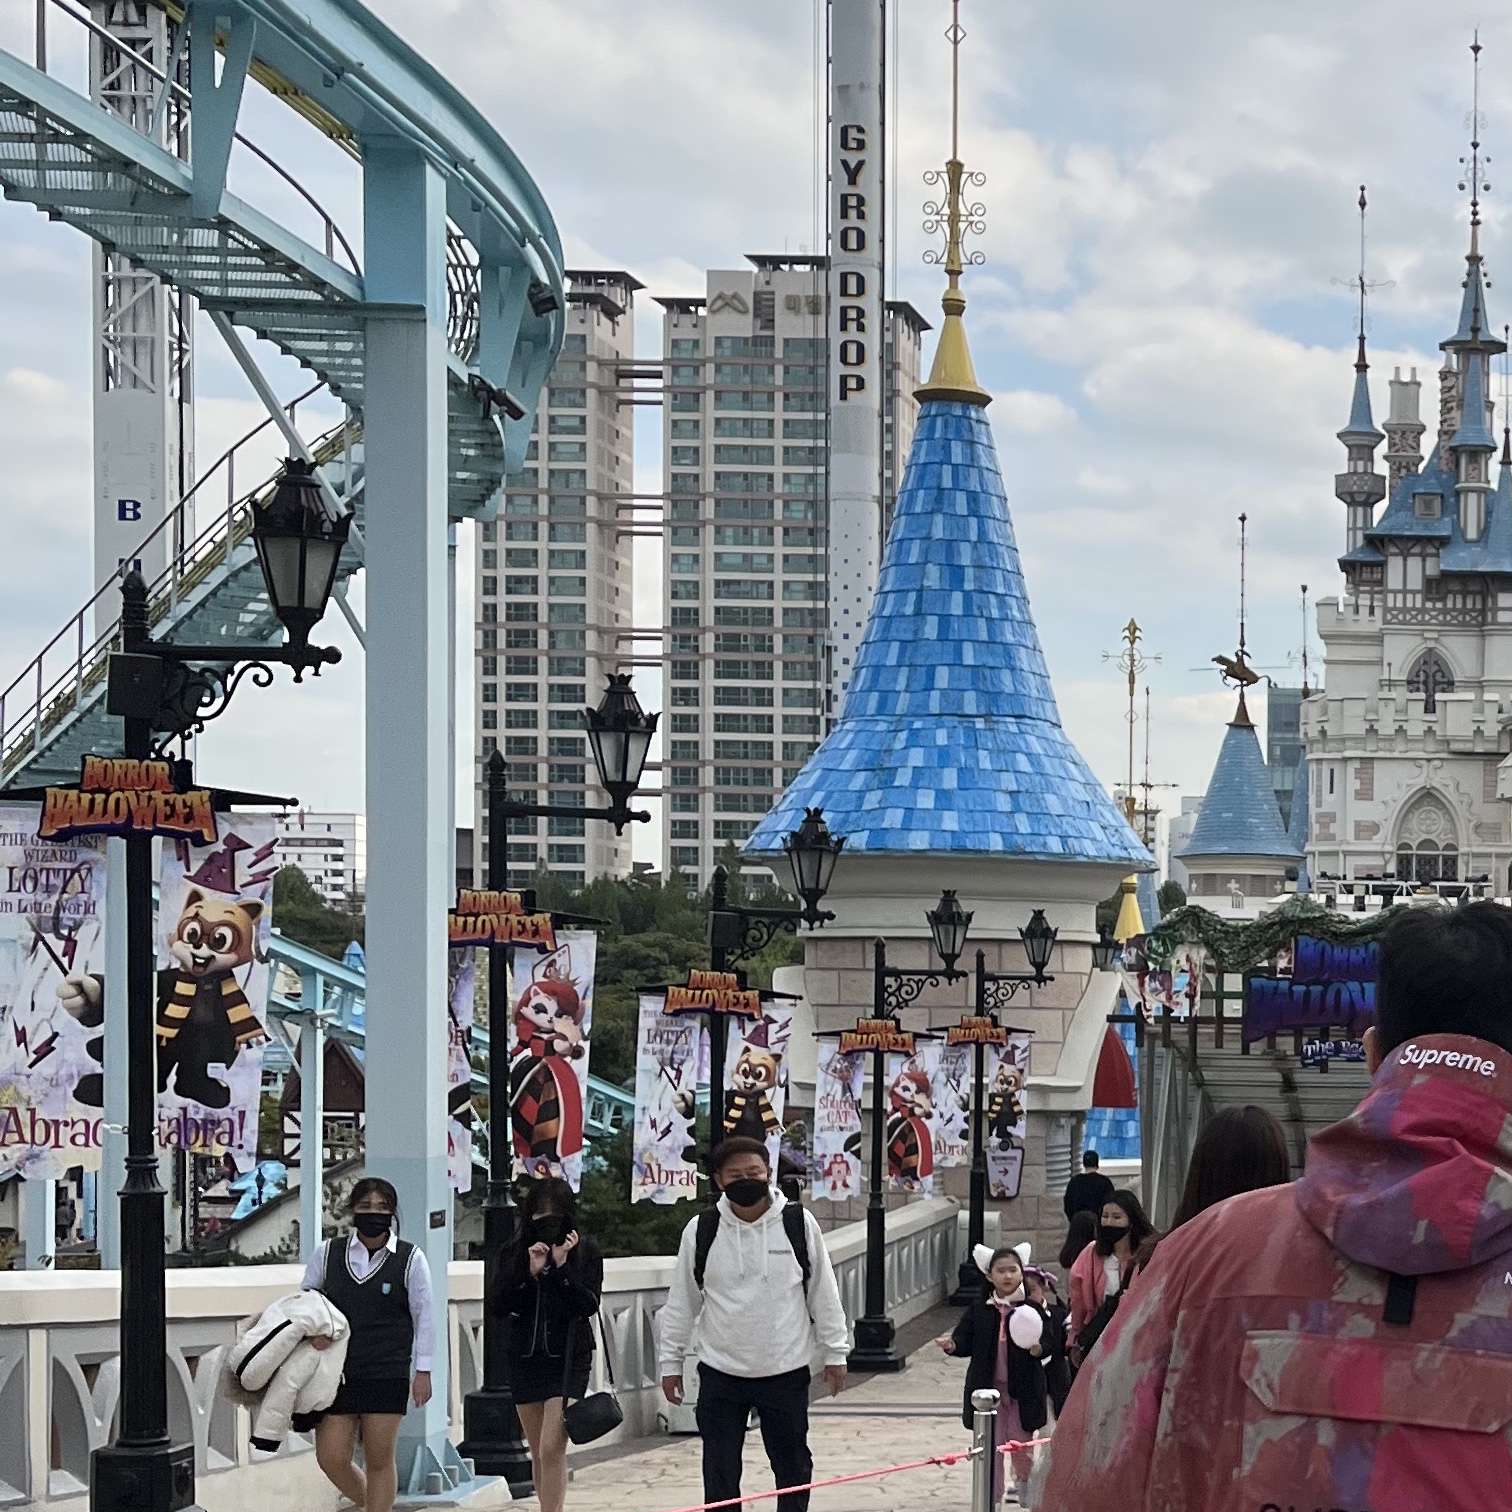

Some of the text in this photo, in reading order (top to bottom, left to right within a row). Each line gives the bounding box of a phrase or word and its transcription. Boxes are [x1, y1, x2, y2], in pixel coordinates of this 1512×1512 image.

[839, 124, 866, 401] GYRO DROP
[82, 756, 175, 792] HORROR
[39, 787, 218, 843] HALLOWEEN
[0, 832, 27, 847] THE
[24, 849, 77, 863] WIZARD
[6, 866, 93, 894] LOTTY
[18, 898, 52, 914] Lotte
[457, 889, 524, 914] HORROR
[448, 912, 556, 951] ALLOWEEN
[1295, 934, 1380, 980] HORRO
[688, 969, 738, 990] HORROR
[664, 985, 762, 1020] HALLOWEEN
[1400, 1044, 1496, 1076] Supreme
